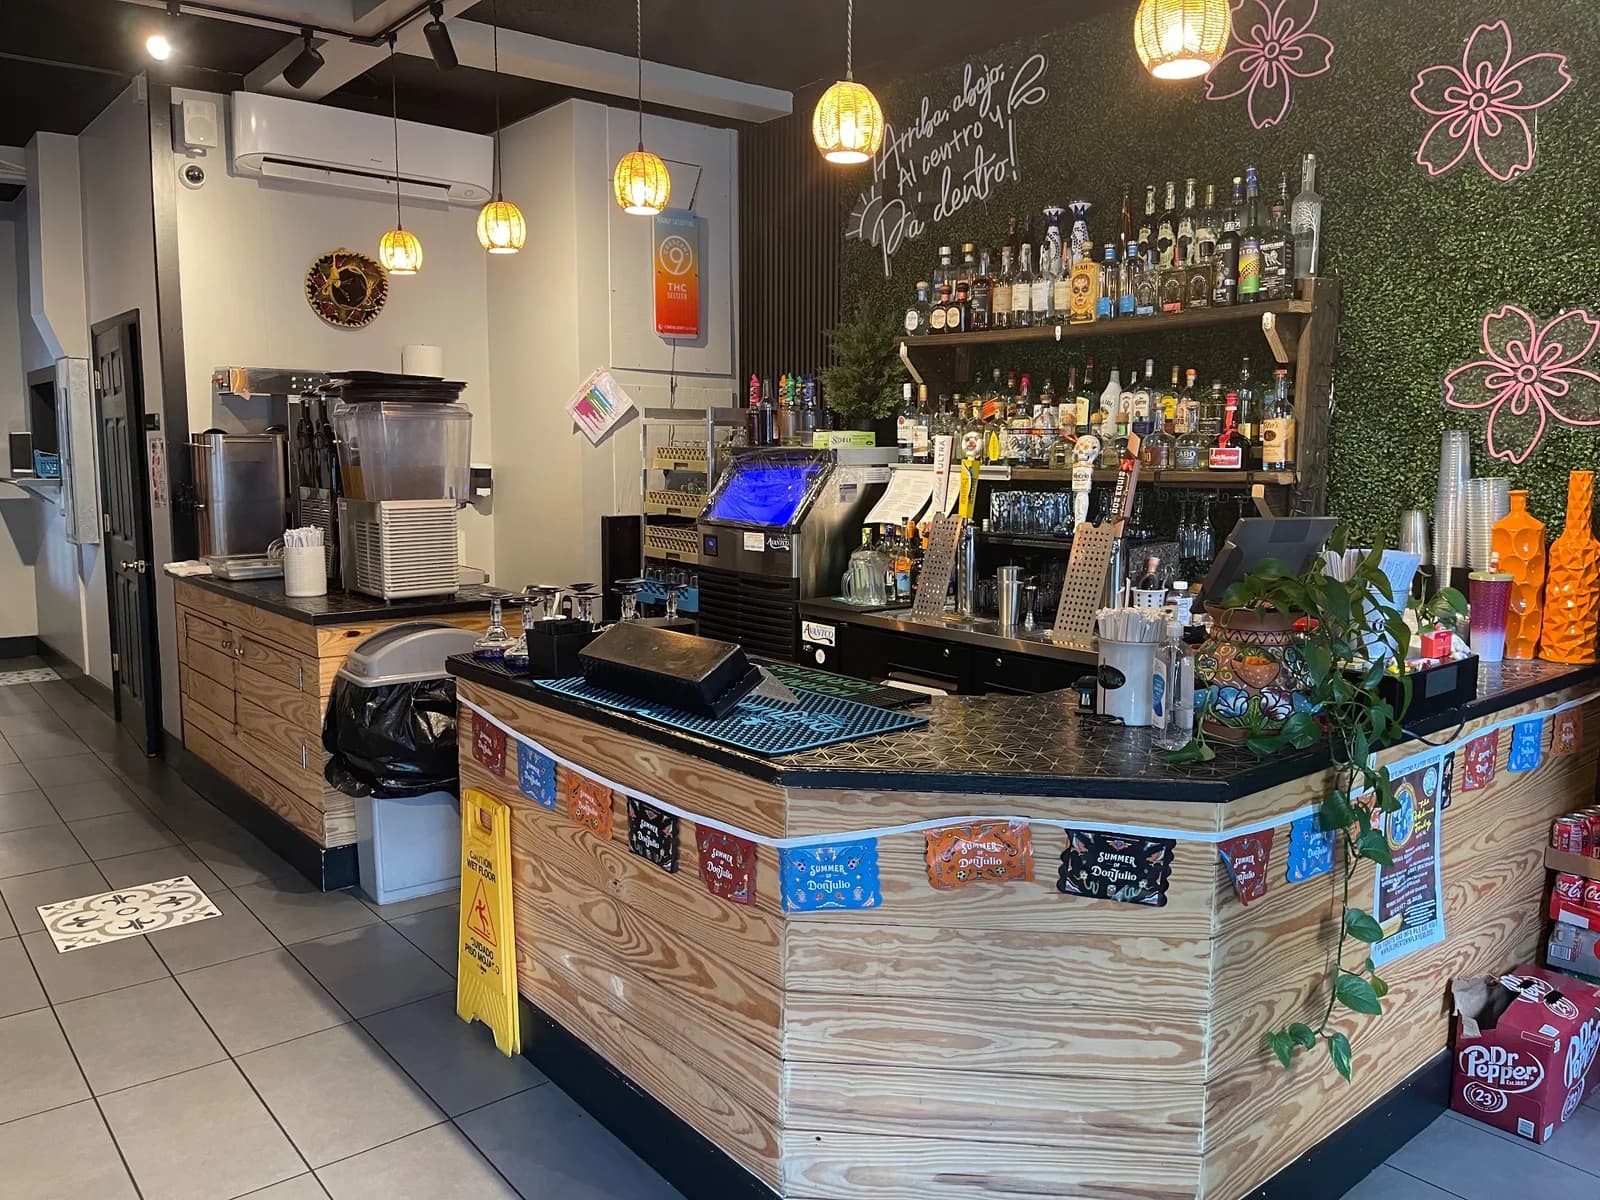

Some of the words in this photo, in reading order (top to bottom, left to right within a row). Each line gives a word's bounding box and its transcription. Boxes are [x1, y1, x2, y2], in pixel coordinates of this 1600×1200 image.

[952, 63, 1004, 118] abajo,
[898, 160, 917, 196] Al
[921, 121, 983, 176] centro
[667, 282, 688, 292] THC
[937, 440, 946, 470] ULTRA
[961, 842, 1003, 853] SUMMER
[467, 858, 478, 870] WET
[1098, 851, 1137, 868] SUMMER
[809, 863, 847, 877] SUMMER
[1488, 1046, 1519, 1066] Dr
[1461, 1046, 1539, 1086] Pepper
[1475, 1089, 1492, 1106] 23
